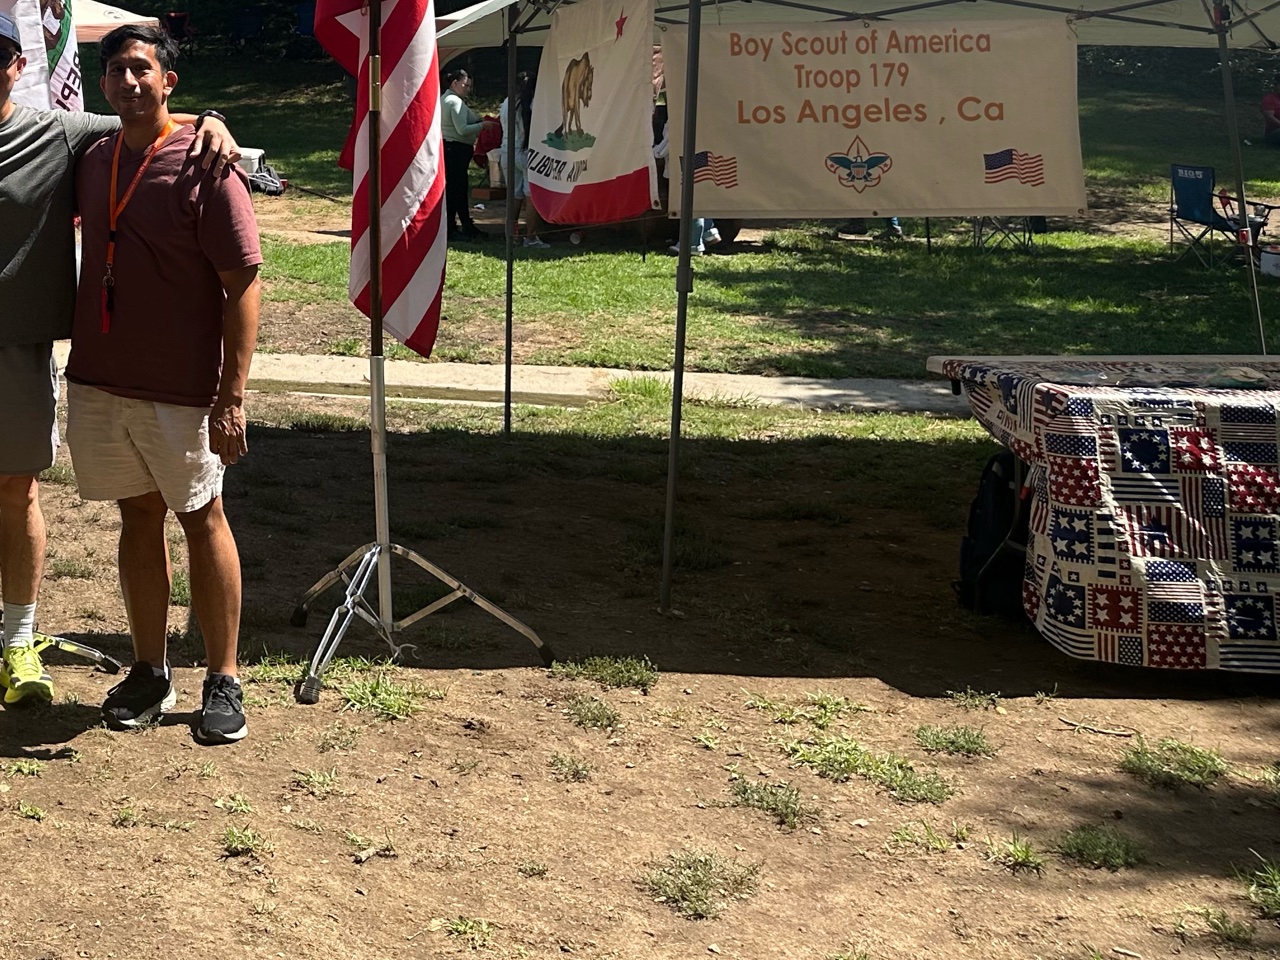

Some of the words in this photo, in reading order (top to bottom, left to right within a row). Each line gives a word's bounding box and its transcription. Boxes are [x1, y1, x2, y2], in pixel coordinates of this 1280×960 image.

[729, 32, 773, 61] Boy
[781, 30, 848, 56] Scout
[855, 29, 878, 54] of
[885, 28, 991, 54] America
[794, 64, 861, 93] Troop
[869, 62, 910, 88] 179
[737, 100, 786, 124] Los
[796, 97, 928, 129] Angeles
[957, 96, 1004, 121] Ca
